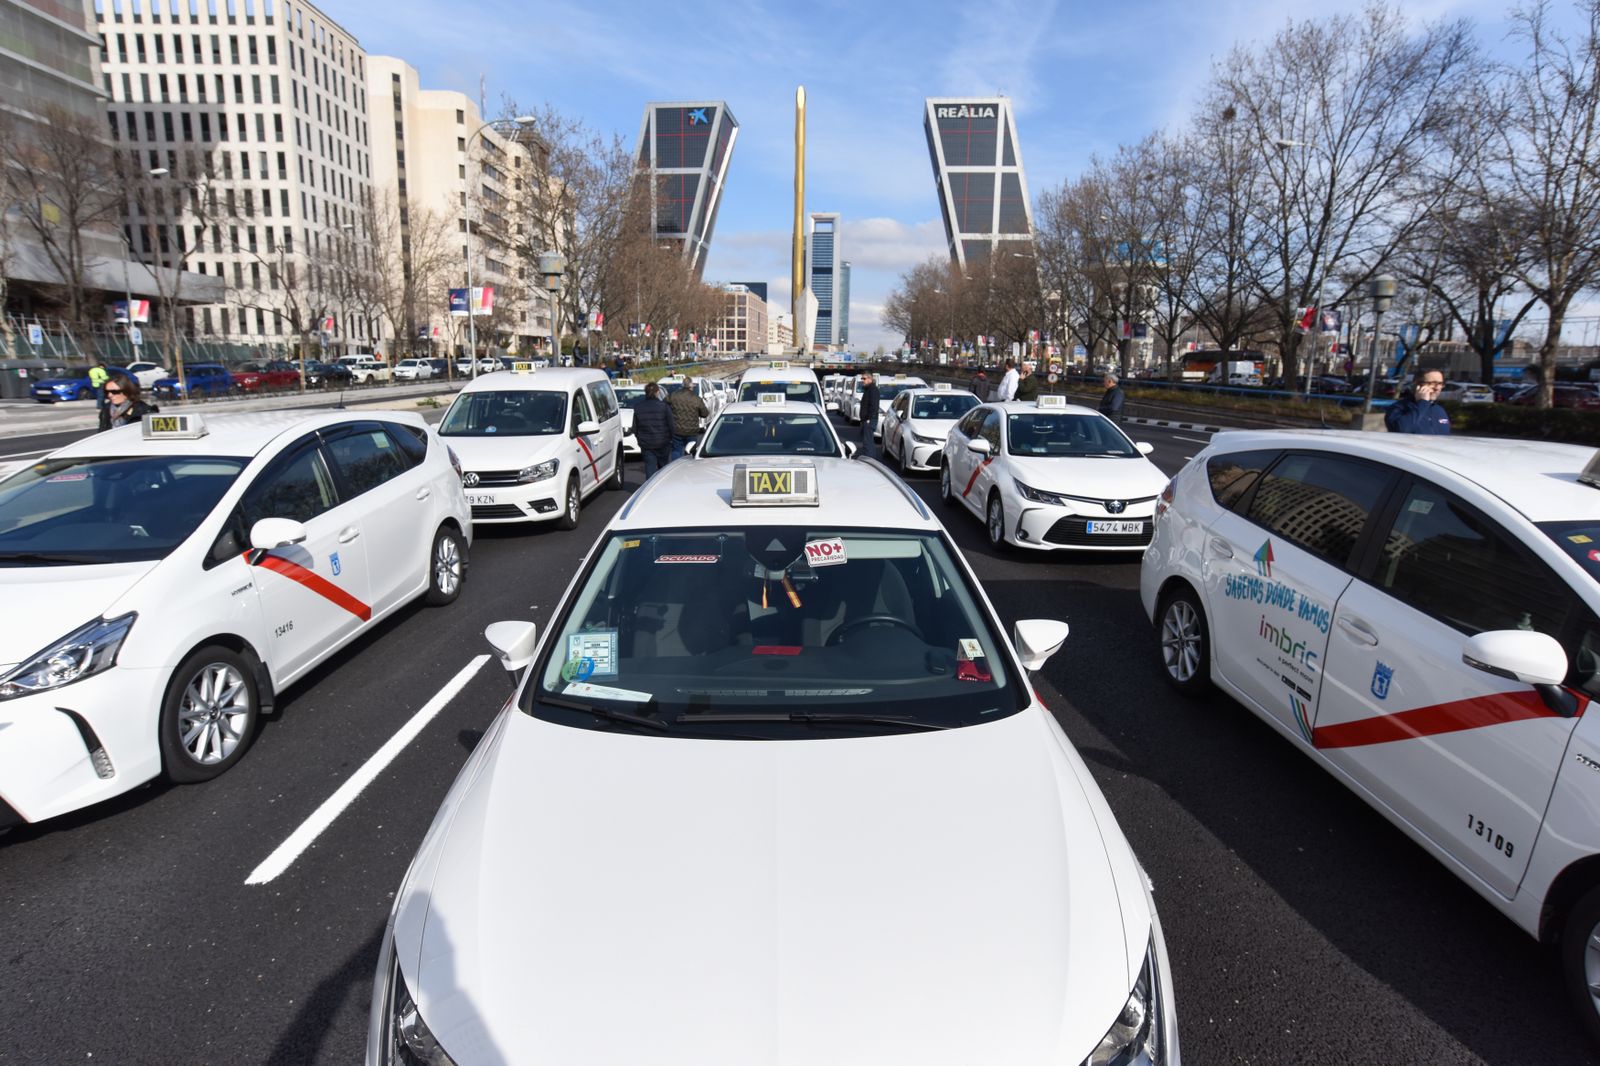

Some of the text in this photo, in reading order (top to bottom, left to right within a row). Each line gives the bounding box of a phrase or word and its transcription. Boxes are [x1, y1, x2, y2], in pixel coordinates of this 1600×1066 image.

[152, 417, 177, 431] TAXI
[750, 472, 791, 493] TAXI
[477, 495, 495, 504] KZN
[1093, 522, 1141, 533] 5474 MBK
[1225, 573, 1264, 604] SABEMOS
[1298, 594, 1330, 634] VAMOS
[274, 620, 294, 638] 13416
[1259, 614, 1318, 672] imbric
[1467, 814, 1515, 858] 13109
